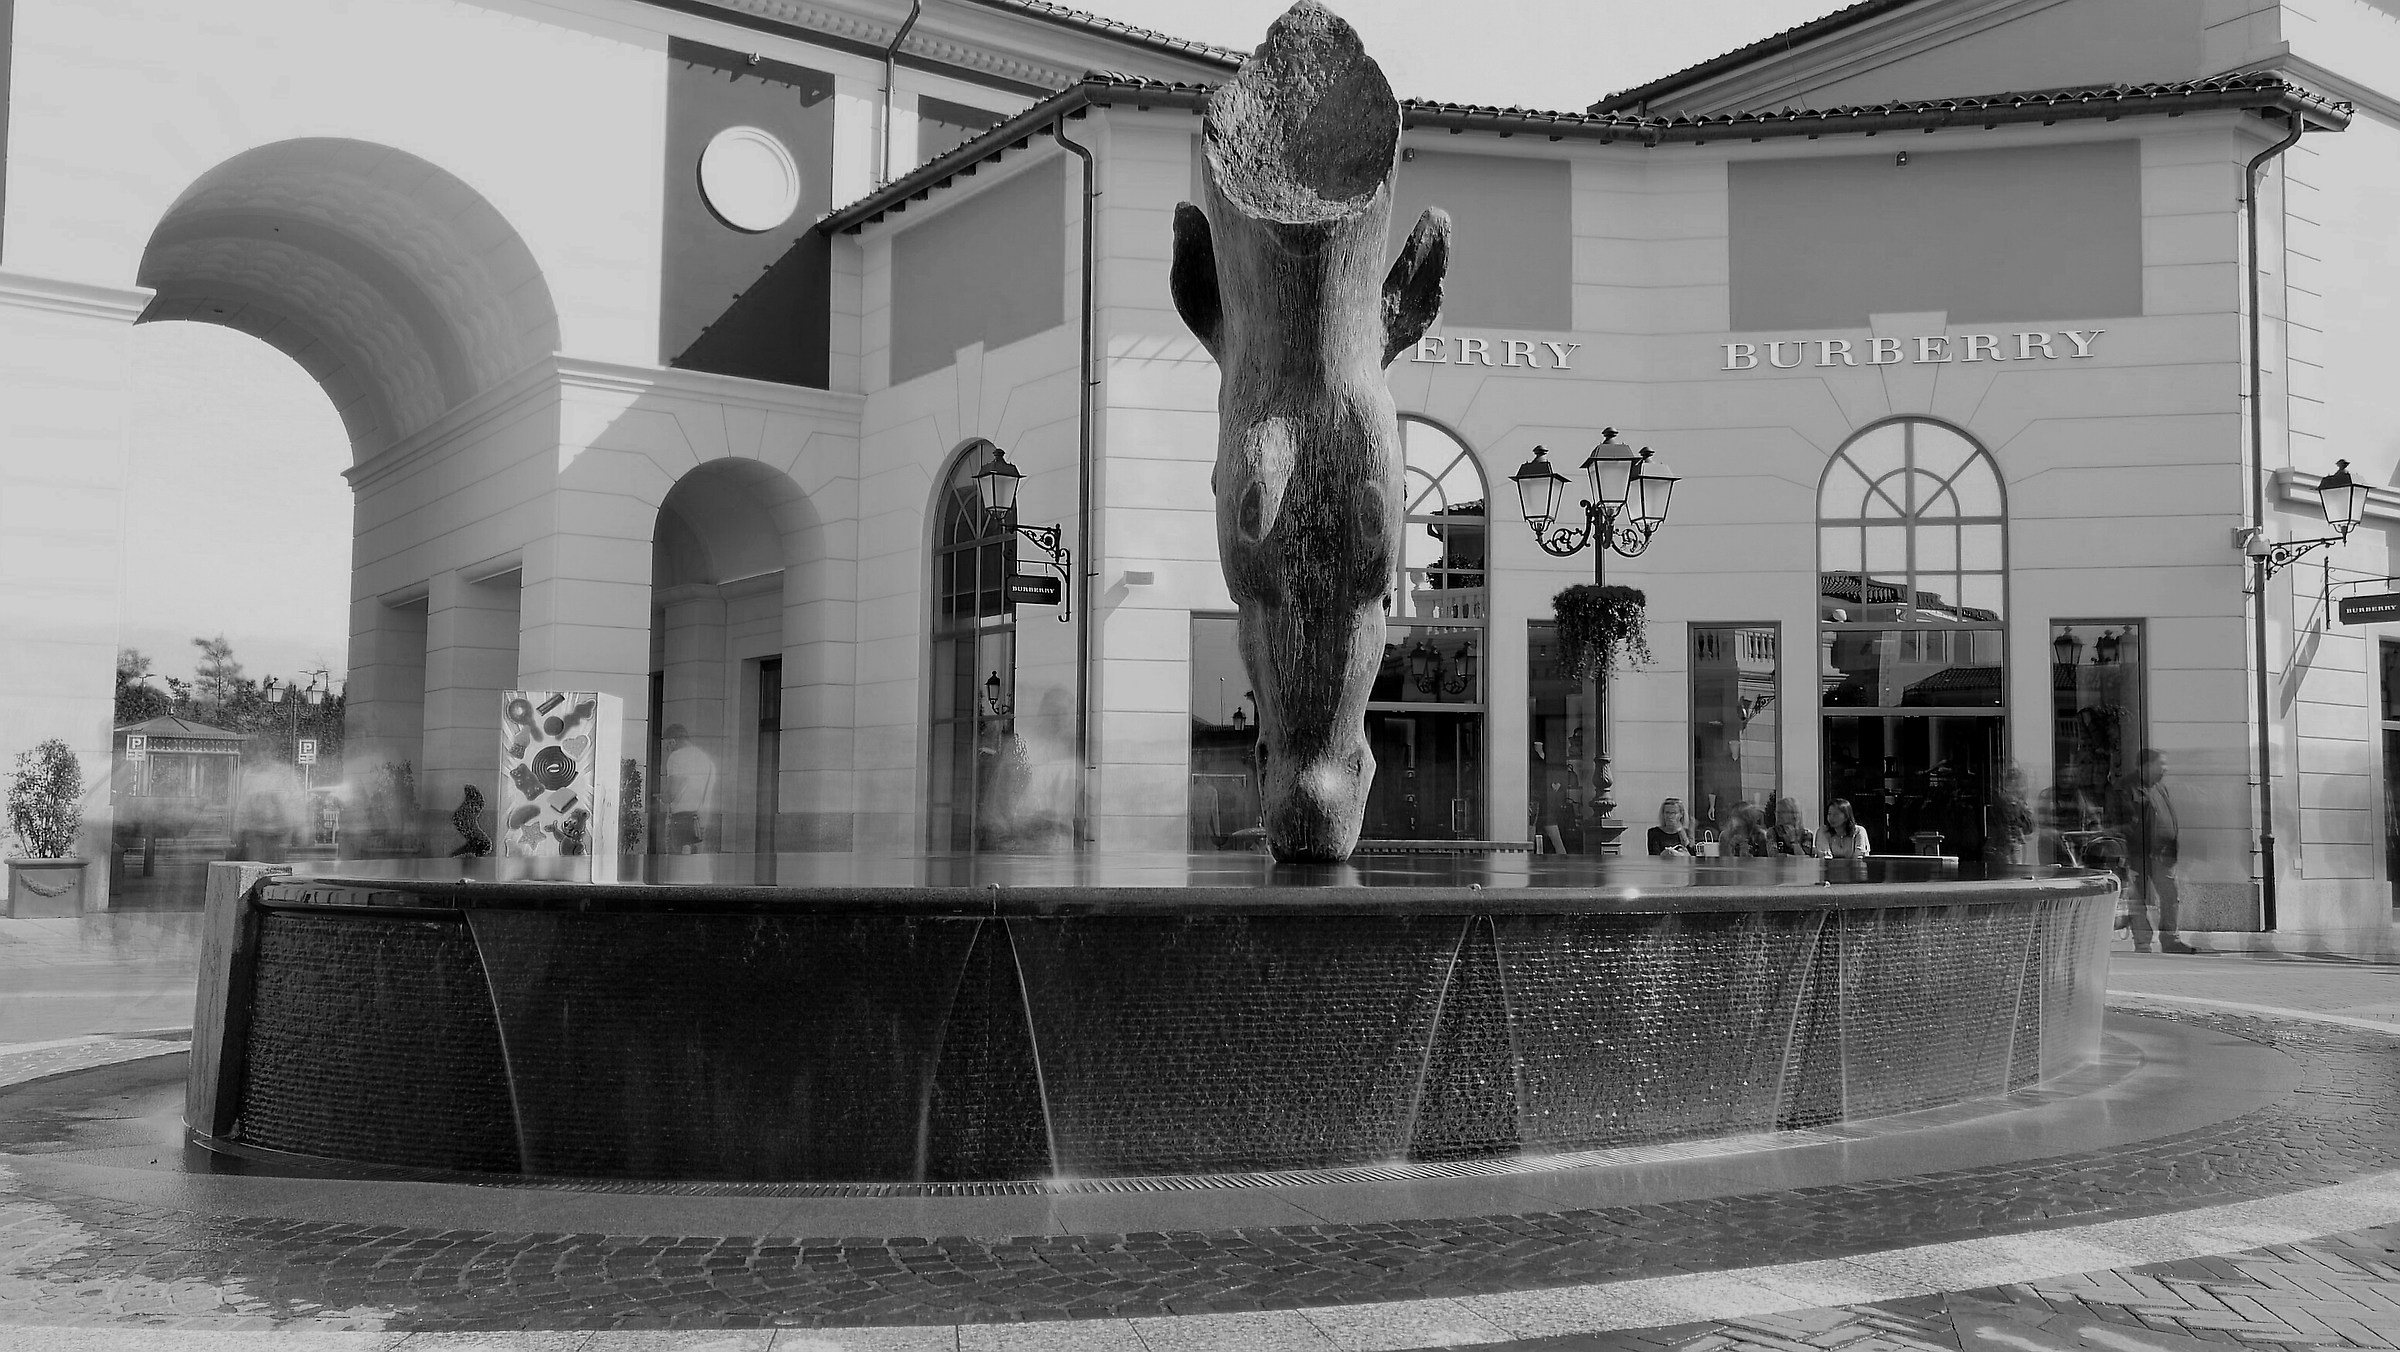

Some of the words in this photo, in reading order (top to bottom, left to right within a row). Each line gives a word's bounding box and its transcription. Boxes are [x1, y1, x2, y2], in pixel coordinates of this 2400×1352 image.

[1410, 336, 1581, 370] ERRY
[1720, 329, 2106, 371] BURBERRY
[1012, 585, 1055, 594] BURBERRY
[2346, 604, 2397, 614] BURBERRY
[132, 738, 142, 749] P
[303, 743, 313, 753] P
